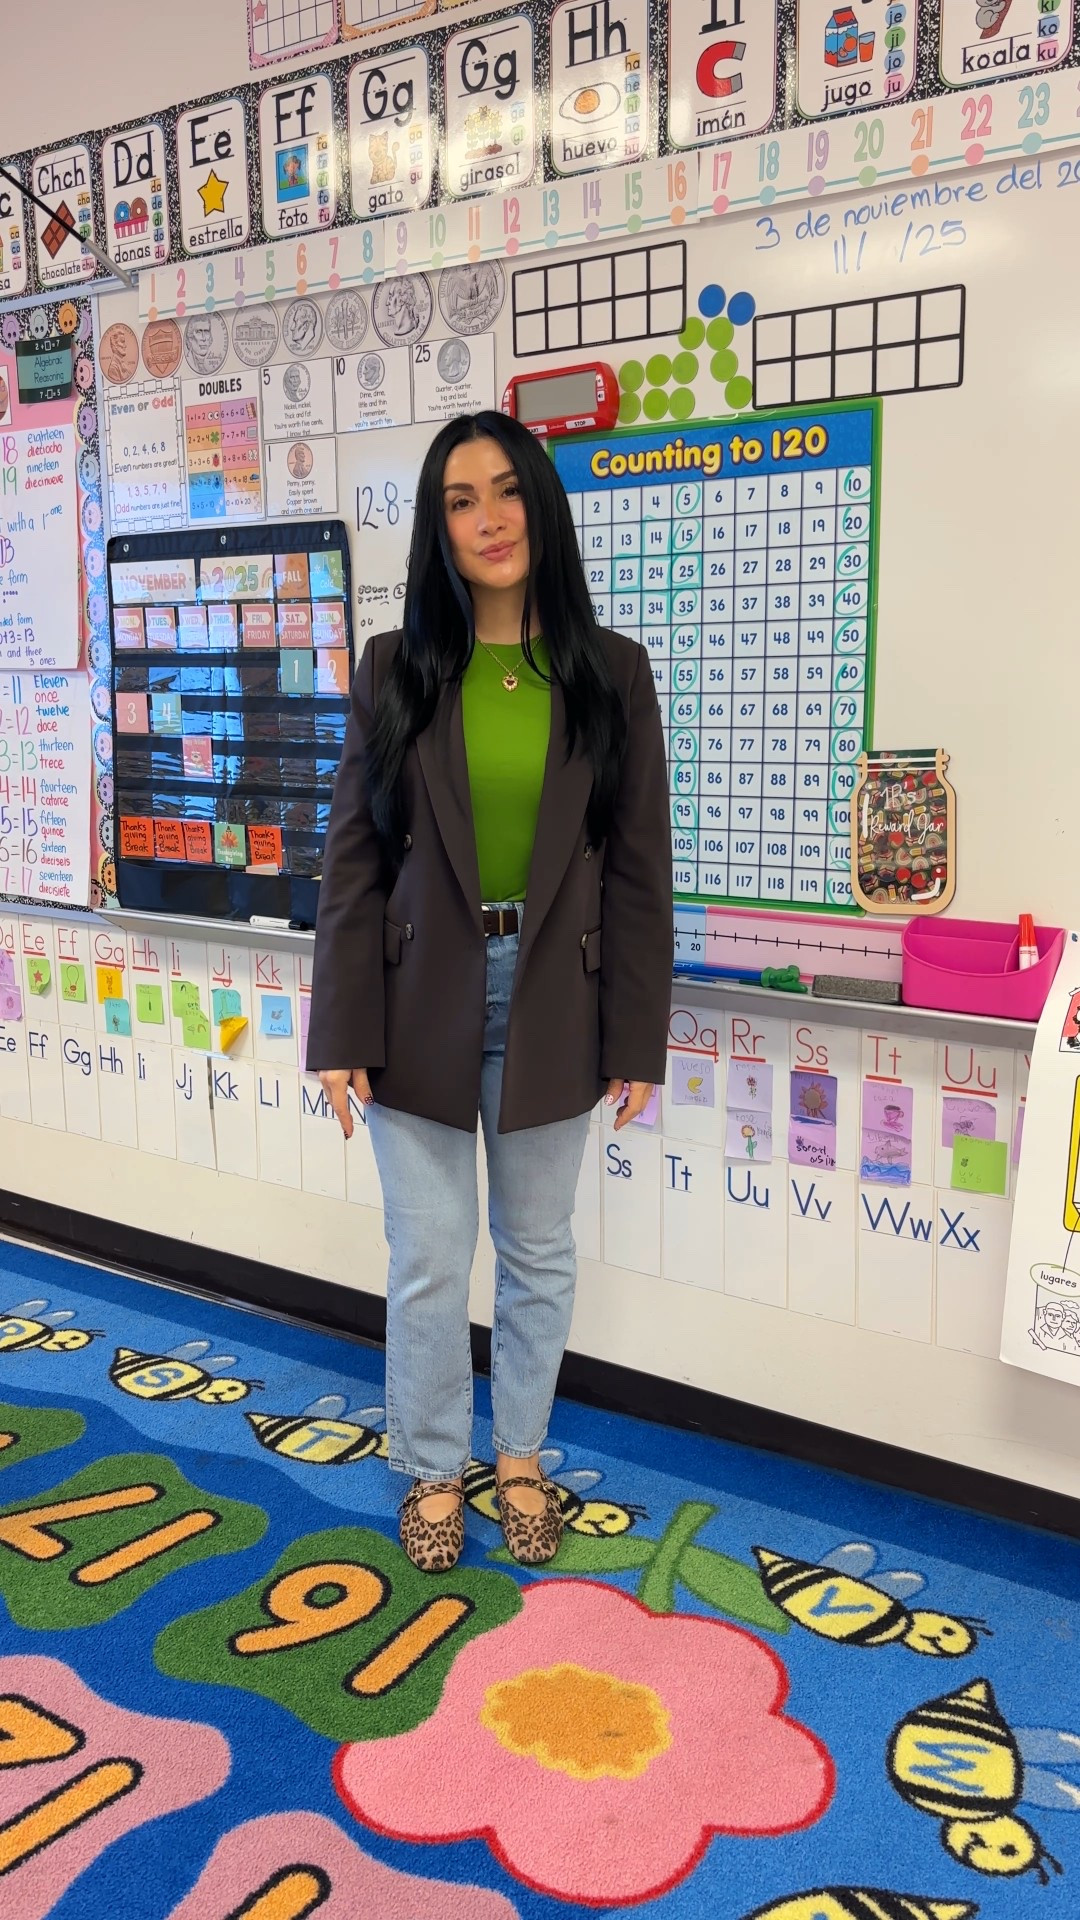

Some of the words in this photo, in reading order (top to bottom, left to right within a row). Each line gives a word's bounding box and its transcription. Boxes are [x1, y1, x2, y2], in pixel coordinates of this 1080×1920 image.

[569, 1, 627, 66] Hh
[461, 39, 516, 100] Gg
[962, 37, 1031, 74] koala
[363, 69, 414, 127] Gg
[821, 81, 872, 112] jugo
[275, 85, 316, 144] Ff
[697, 110, 745, 136] imán
[191, 117, 232, 166] Ee
[562, 137, 617, 162] huevo
[114, 132, 154, 186] Dd
[460, 153, 520, 192] girasol
[38, 157, 85, 195] Chch
[151, 273, 156, 302] 1
[177, 268, 186, 298] 2
[205, 262, 215, 293] 3
[235, 257, 245, 286] 4
[266, 250, 275, 281] 5
[296, 243, 307, 275] 6
[329, 236, 339, 269] 7
[362, 229, 373, 263] 8
[396, 221, 408, 255] 9
[429, 213, 446, 248] 10
[468, 205, 480, 241] 11
[503, 197, 521, 234] 12
[543, 189, 560, 227] 13
[583, 179, 601, 219] 14
[625, 171, 643, 211] 15
[667, 161, 687, 202] 16
[712, 151, 732, 191] 17
[759, 140, 780, 182] 18
[807, 130, 829, 172] 19
[854, 118, 884, 162] 20
[911, 106, 933, 150] 21
[960, 94, 993, 140] 22
[1018, 82, 1051, 129] 23
[369, 186, 404, 213] gato
[756, 217, 780, 250] 3
[796, 210, 830, 239] de
[844, 182, 987, 228] noviembre
[996, 160, 1042, 194] del
[189, 218, 243, 247] estrella
[278, 208, 308, 229] foto
[114, 244, 151, 263] donas
[41, 259, 81, 280] chocolate
[335, 357, 346, 376] 10
[415, 344, 431, 363] 25
[34, 372, 64, 383] Reasoning
[199, 378, 242, 397] DOUBLES
[263, 369, 271, 386] 5
[111, 404, 136, 416] Even
[138, 402, 150, 411] or
[152, 397, 174, 410] Odd
[2, 435, 19, 465] 18
[27, 428, 65, 447] eighteen
[590, 438, 724, 478] Counting
[729, 435, 763, 463] to
[770, 425, 829, 460] 120
[2, 465, 18, 496] 19
[26, 457, 60, 474] nineteen
[25, 474, 64, 490] diecinueve
[593, 501, 601, 514] 2
[622, 498, 630, 511] 3
[652, 495, 661, 509] 4
[683, 493, 691, 506] 5
[714, 490, 723, 503] 6
[747, 487, 756, 501] 7
[780, 484, 789, 498] 8
[815, 481, 823, 495] 9
[847, 478, 862, 492] 10
[120, 572, 187, 592] NOVEMBER
[211, 564, 259, 593] 2025
[282, 570, 303, 583] FALL
[252, 614, 265, 624] FRI.
[285, 613, 303, 624] SAT.
[247, 630, 271, 640] FRIDAY
[281, 630, 309, 640] SATURDAY
[34, 674, 69, 689] Eleven
[293, 660, 299, 684] 1
[327, 659, 338, 684] 2
[34, 690, 60, 703] once
[36, 705, 70, 717] twelve
[127, 703, 137, 725] 3
[162, 703, 171, 725] 4
[37, 720, 58, 733] doce
[38, 738, 74, 751] thirteen
[40, 755, 65, 770] trece
[40, 778, 78, 794] fourteen
[41, 794, 69, 807] catorce
[40, 810, 67, 827] fifteen
[120, 821, 147, 832] Thanks
[870, 809, 914, 838] Reward
[917, 813, 943, 844] Jar
[40, 843, 67, 854] sixteen
[124, 832, 147, 842] giving
[125, 842, 148, 853] Break
[249, 829, 275, 840] Thanks
[253, 839, 276, 851] giving
[39, 870, 73, 882] seventeen
[23, 924, 45, 951] Ee
[58, 928, 78, 956] Ff
[95, 933, 126, 973] Gg
[132, 937, 159, 967] Hh
[213, 949, 232, 987] Jj
[256, 953, 282, 984] Kk
[29, 1032, 49, 1058] Ff
[669, 1010, 719, 1063] Qq
[732, 1018, 766, 1055] Rr
[796, 1028, 828, 1065] Ss
[63, 1038, 91, 1076] Gg
[99, 1045, 124, 1074] Hh
[867, 1035, 902, 1076] Tt
[945, 1045, 997, 1089] Uu
[175, 1063, 193, 1100] Jj
[214, 1069, 239, 1100] Kk
[606, 1144, 632, 1178] Ss
[665, 1154, 693, 1191] Tt
[728, 1167, 769, 1208] Uu
[791, 1179, 832, 1220] Vv
[861, 1193, 932, 1241] Ww
[940, 1208, 981, 1252] Xx
[1040, 1270, 1077, 1288] lugares
[135, 1366, 185, 1388] S
[294, 1424, 350, 1454] T
[809, 1585, 876, 1617] V
